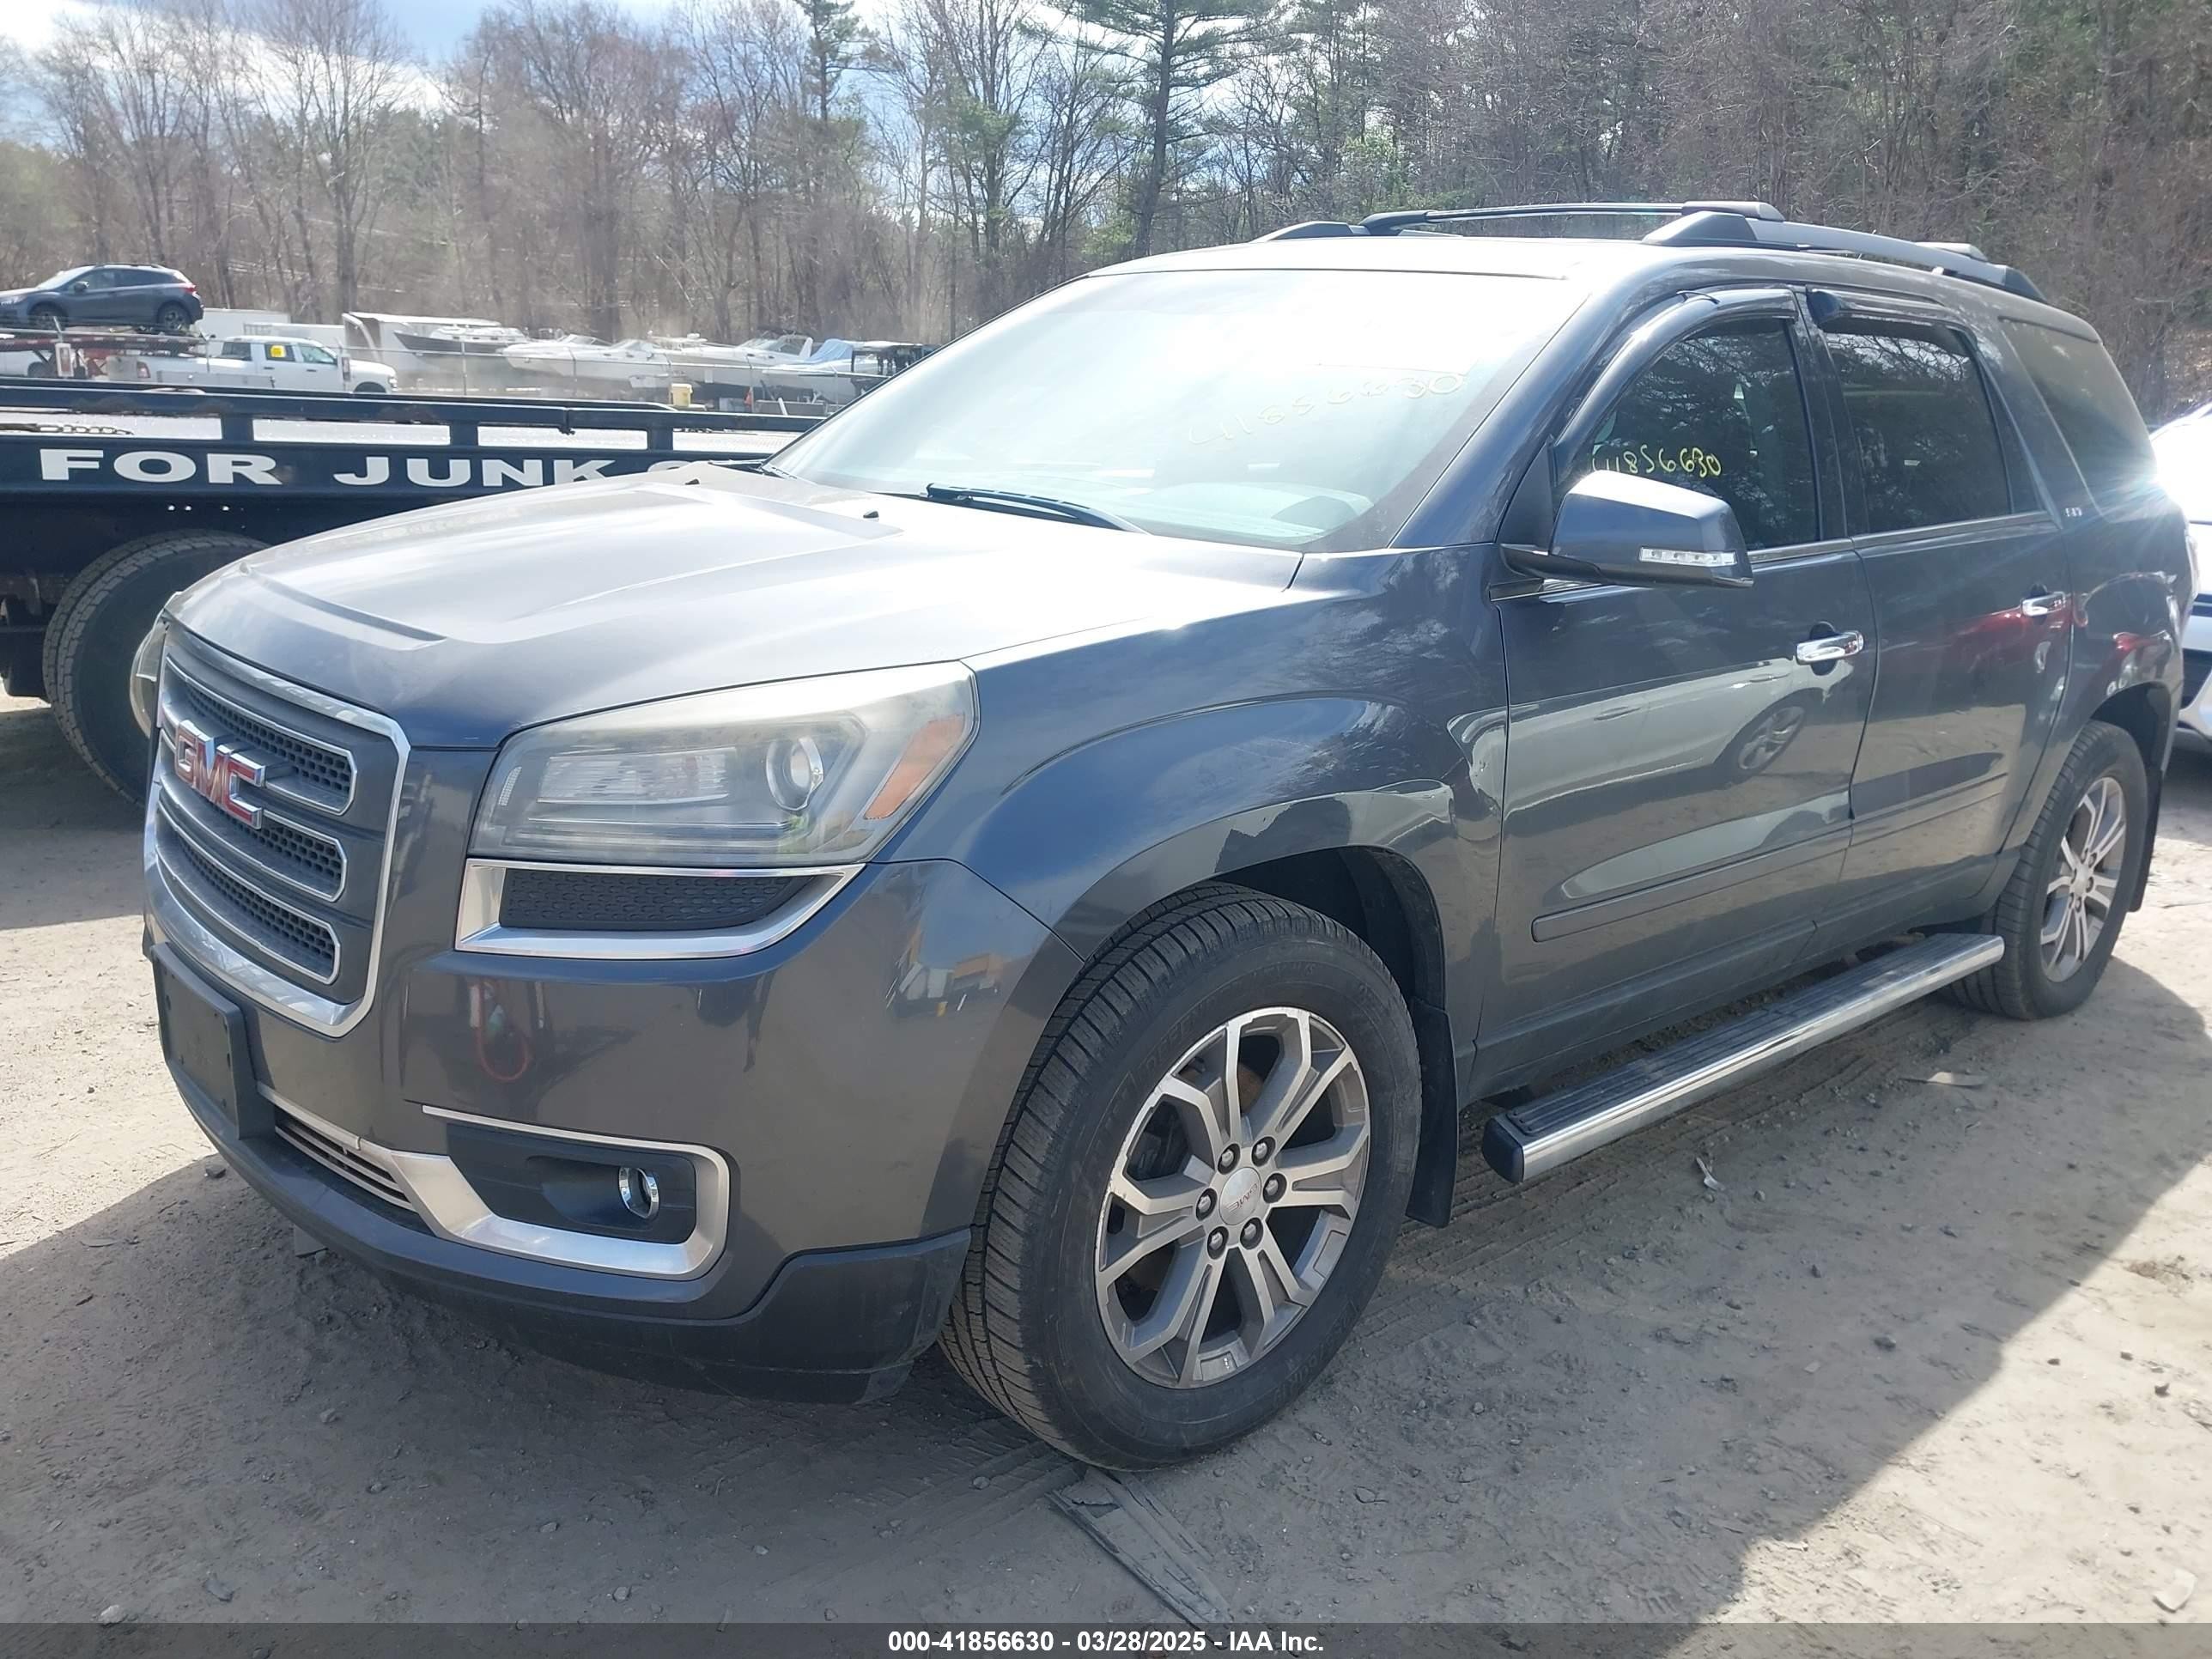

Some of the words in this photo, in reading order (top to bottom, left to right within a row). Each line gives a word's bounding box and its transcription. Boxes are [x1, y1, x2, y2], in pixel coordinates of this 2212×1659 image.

[40, 448, 283, 485] FOR
[333, 456, 617, 488] JUNK
[1592, 444, 1722, 477] 41856630
[174, 720, 266, 830] GMC
